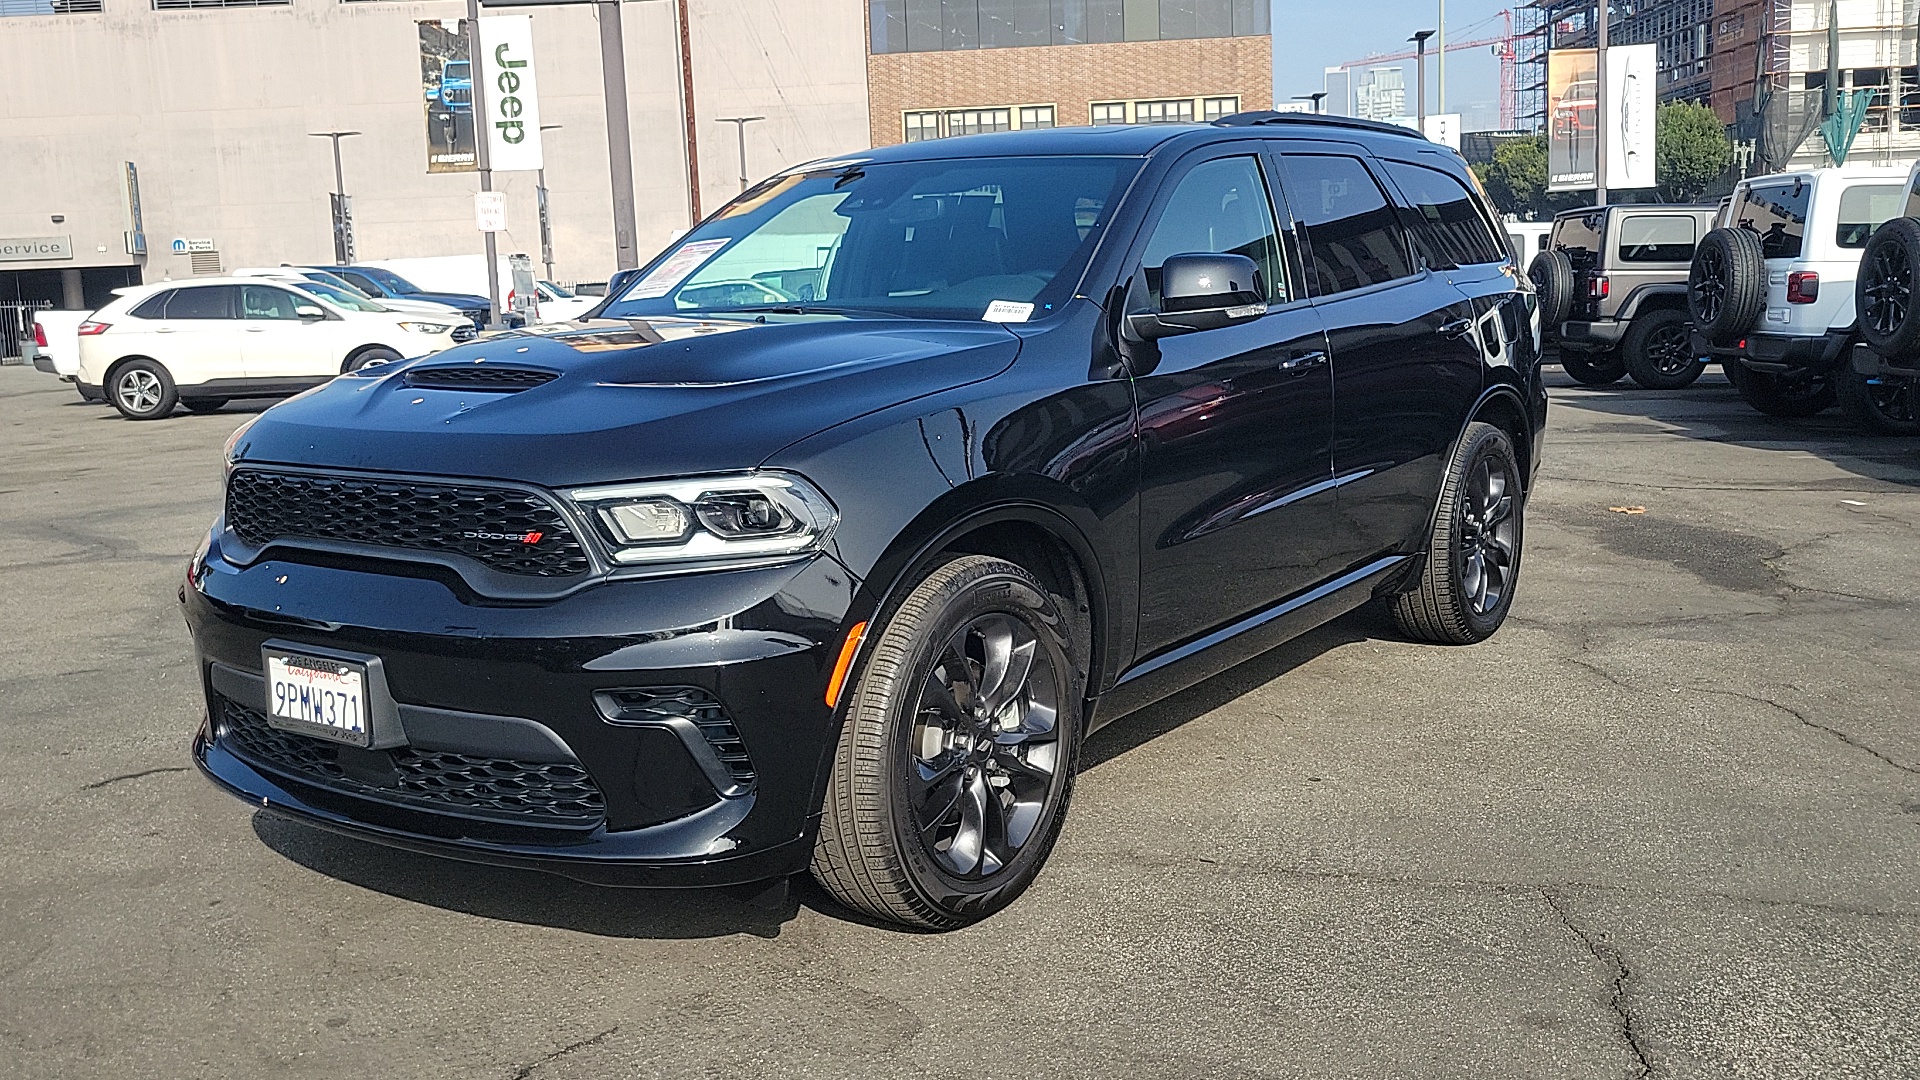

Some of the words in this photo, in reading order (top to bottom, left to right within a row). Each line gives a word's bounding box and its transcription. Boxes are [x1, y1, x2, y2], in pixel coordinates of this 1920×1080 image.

[495, 42, 528, 145] Jeep
[0, 241, 61, 255] ervice
[463, 531, 529, 541] DODGE
[275, 681, 362, 733] 9PMW371
